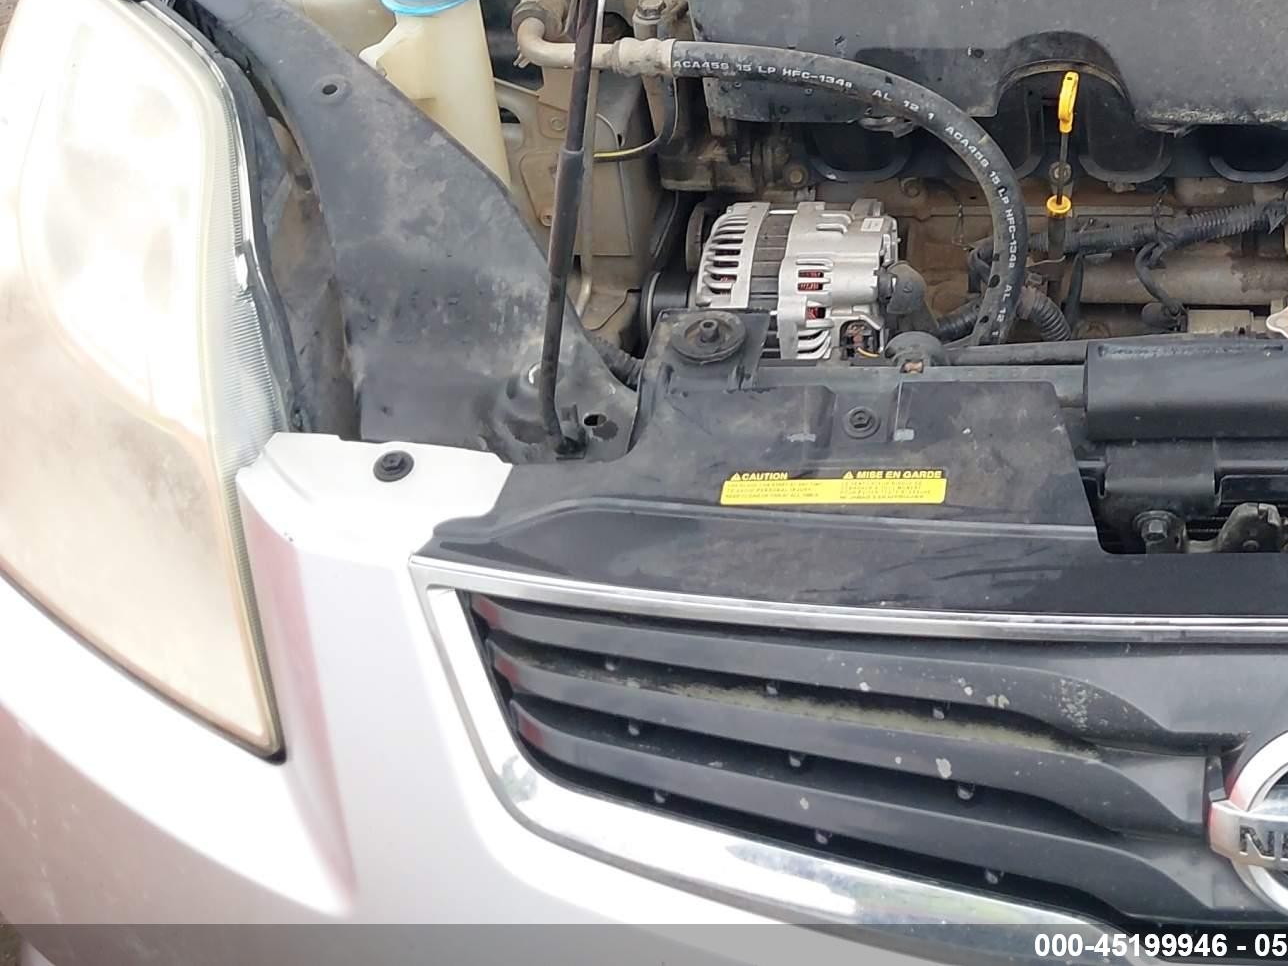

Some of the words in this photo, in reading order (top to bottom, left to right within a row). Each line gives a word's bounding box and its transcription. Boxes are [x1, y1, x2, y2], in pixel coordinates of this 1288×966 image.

[736, 64, 751, 72] 15
[758, 65, 776, 74] LP
[782, 68, 852, 88] HFC-134a
[872, 89, 893, 101] AL
[741, 472, 788, 481] CAUTION
[856, 470, 883, 479] MISE
[885, 470, 901, 479] EN
[903, 470, 942, 479] GARDE
